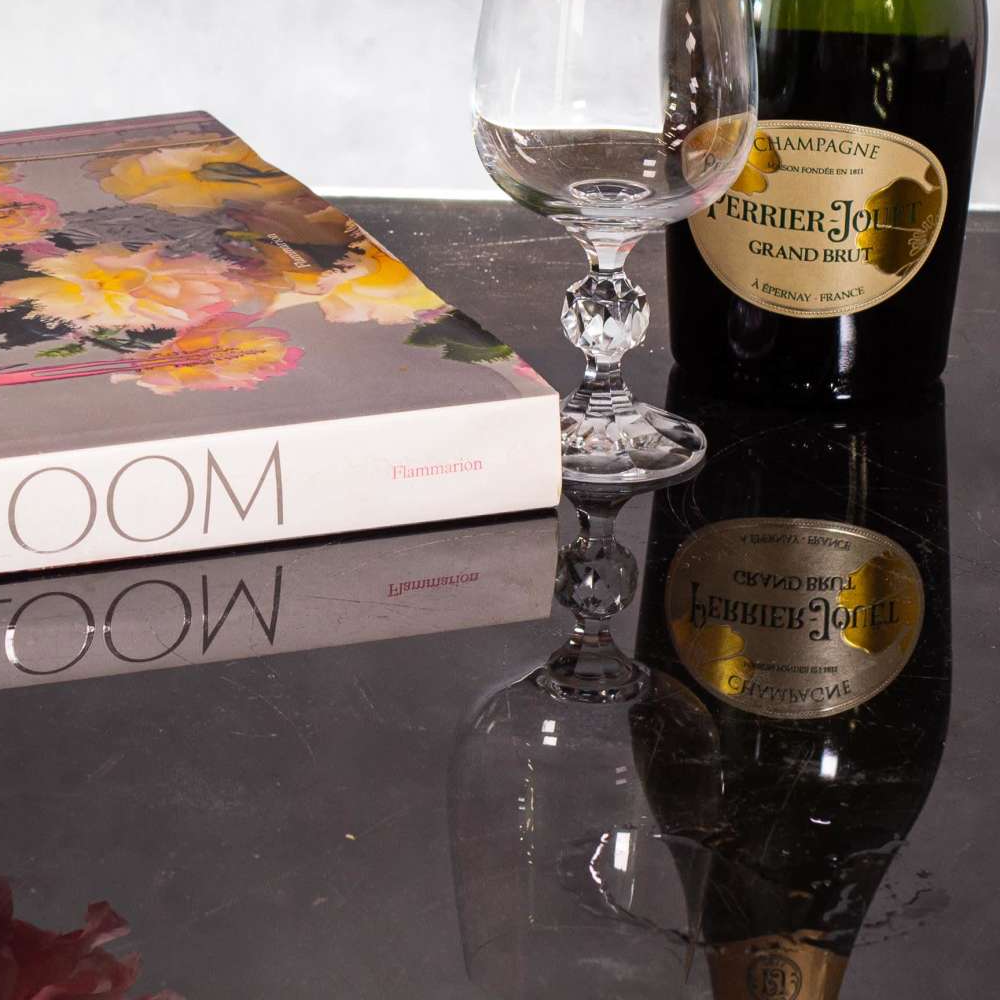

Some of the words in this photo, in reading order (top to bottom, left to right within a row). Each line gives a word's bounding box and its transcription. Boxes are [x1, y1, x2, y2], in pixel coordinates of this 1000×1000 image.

[753, 135, 881, 160] CHAMPAGNE
[801, 165, 835, 175] FONDÉE
[836, 167, 848, 175] EN
[748, 239, 819, 263] GRAND
[822, 245, 873, 264] BRUT
[762, 283, 812, 302] ÉPERNAY
[820, 286, 865, 302] FRANCE
[391, 456, 484, 481] Flammarion
